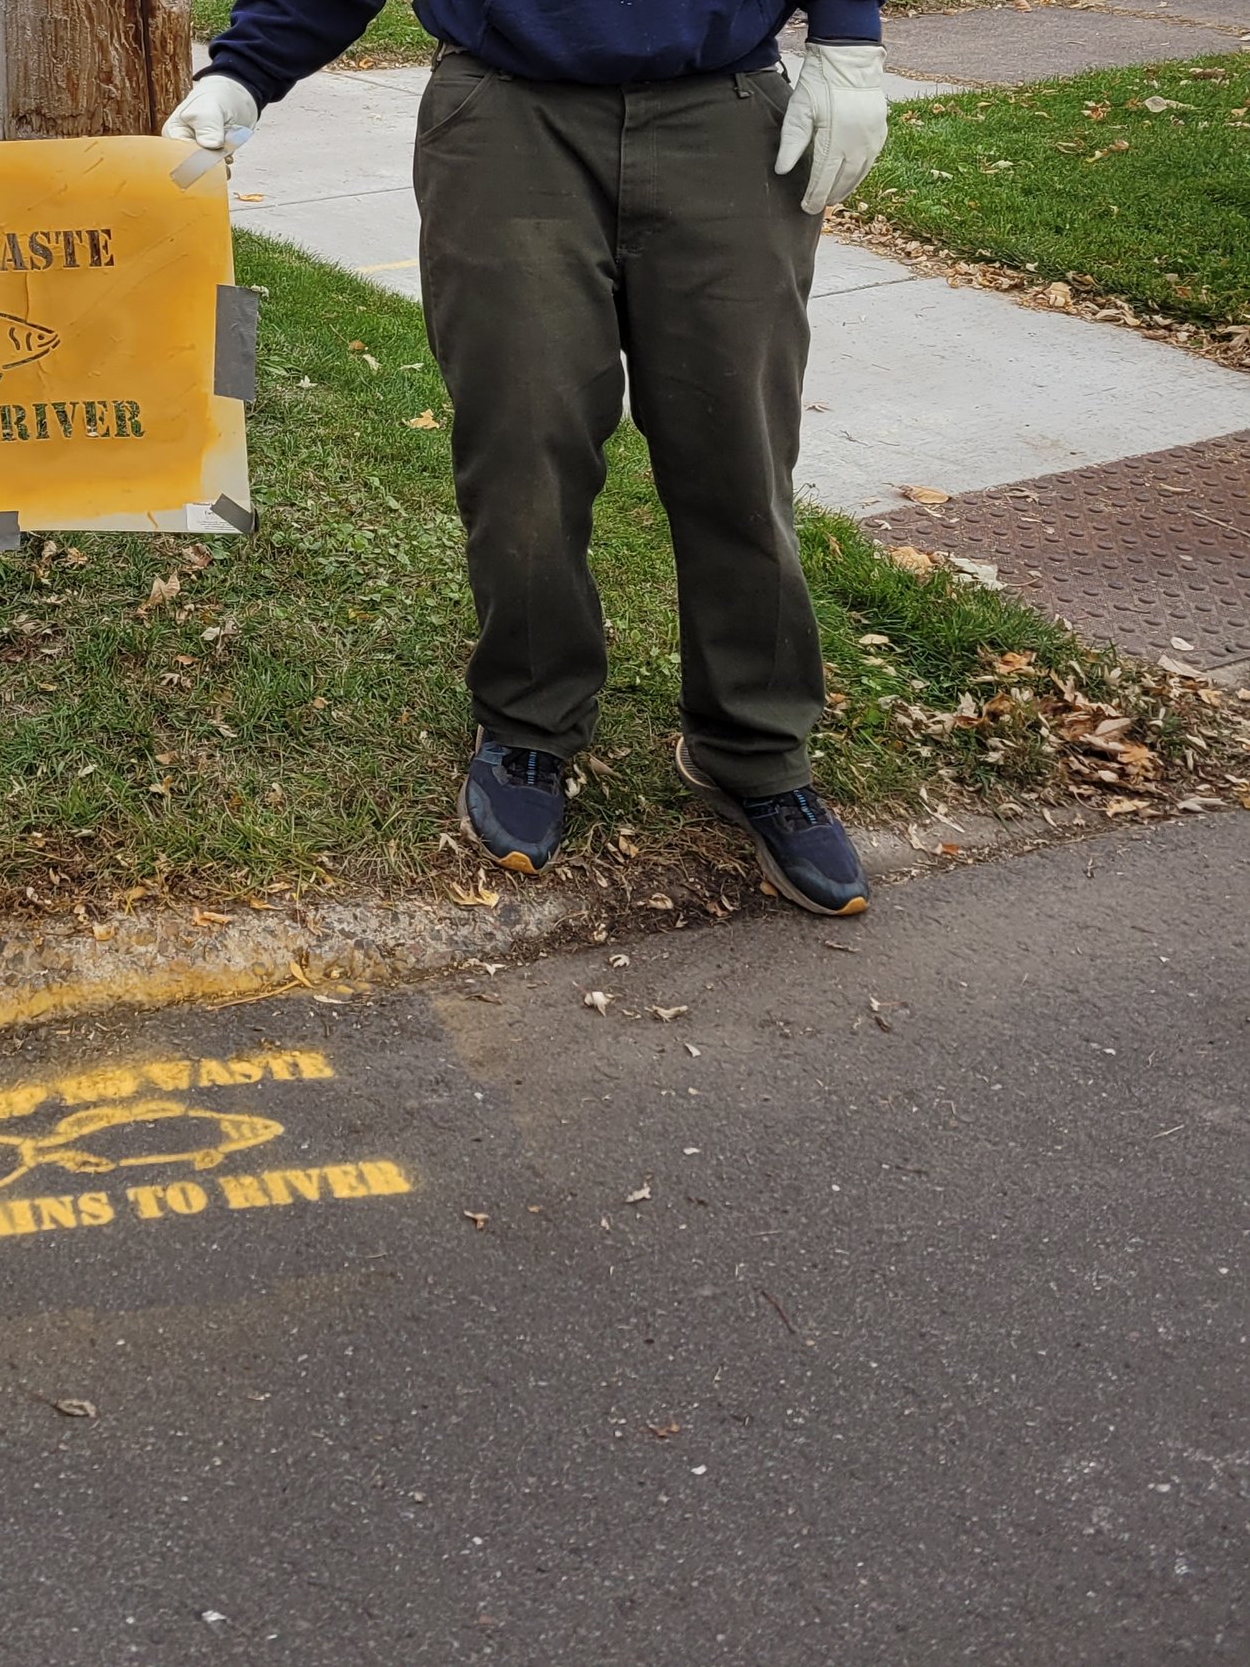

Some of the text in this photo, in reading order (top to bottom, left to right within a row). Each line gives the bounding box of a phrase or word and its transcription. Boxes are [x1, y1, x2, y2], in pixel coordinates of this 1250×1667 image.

[0, 398, 146, 443] RIVER
[126, 1180, 209, 1220] TO
[218, 1160, 413, 1210] RIVER
